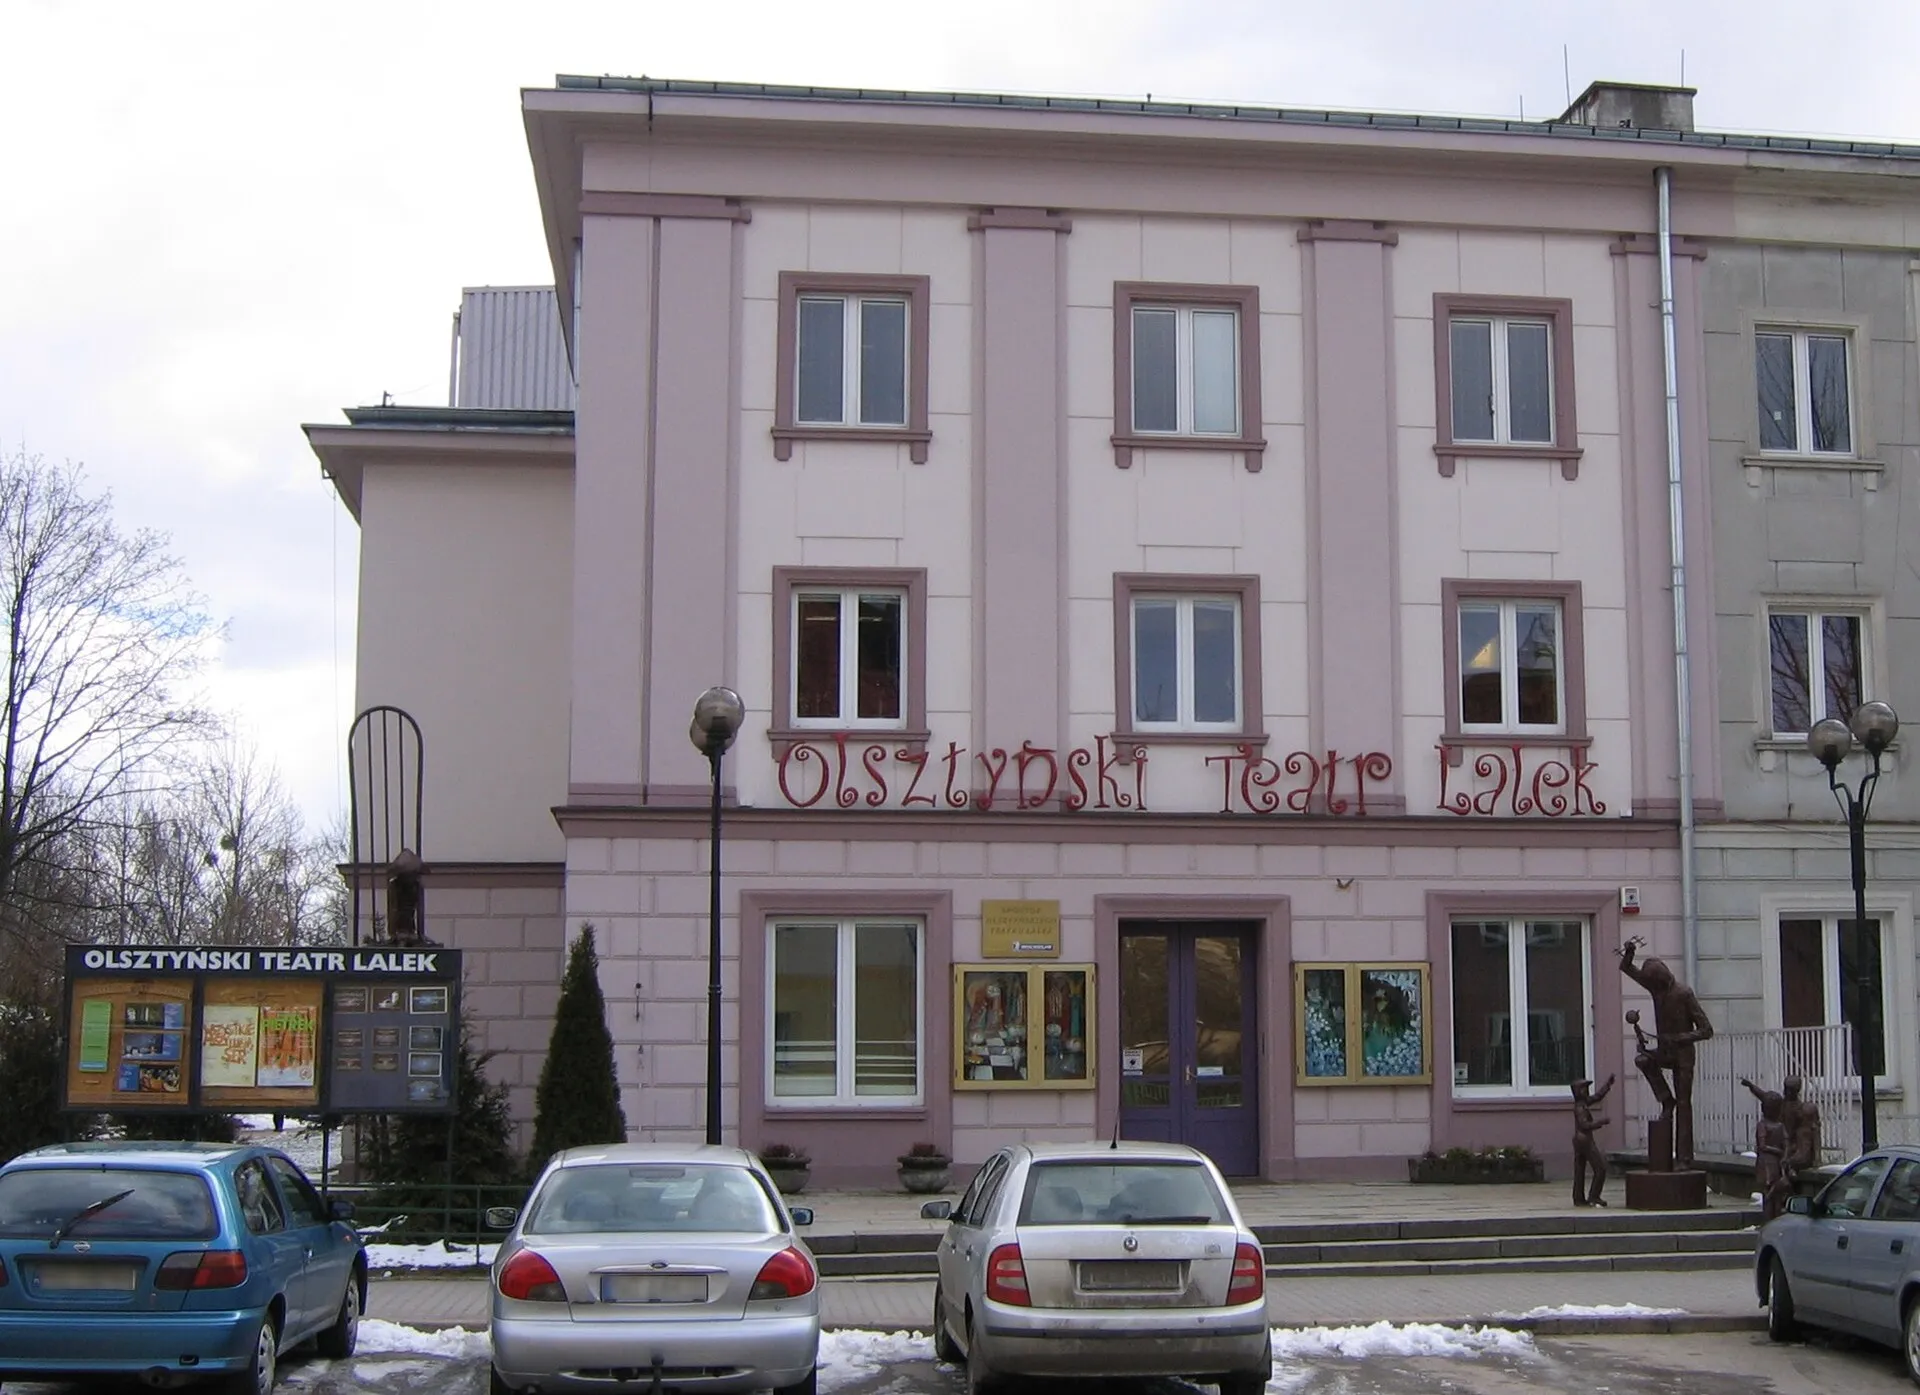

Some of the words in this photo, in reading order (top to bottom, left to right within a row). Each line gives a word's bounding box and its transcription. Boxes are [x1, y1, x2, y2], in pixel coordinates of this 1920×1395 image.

[779, 732, 1148, 811] Olsztyński
[1205, 741, 1392, 815] Teatr
[1434, 741, 1606, 816] Lalek
[84, 947, 250, 970] OLSZTYŃSKI
[259, 951, 345, 971] TEATR
[353, 952, 438, 972] LALEK
